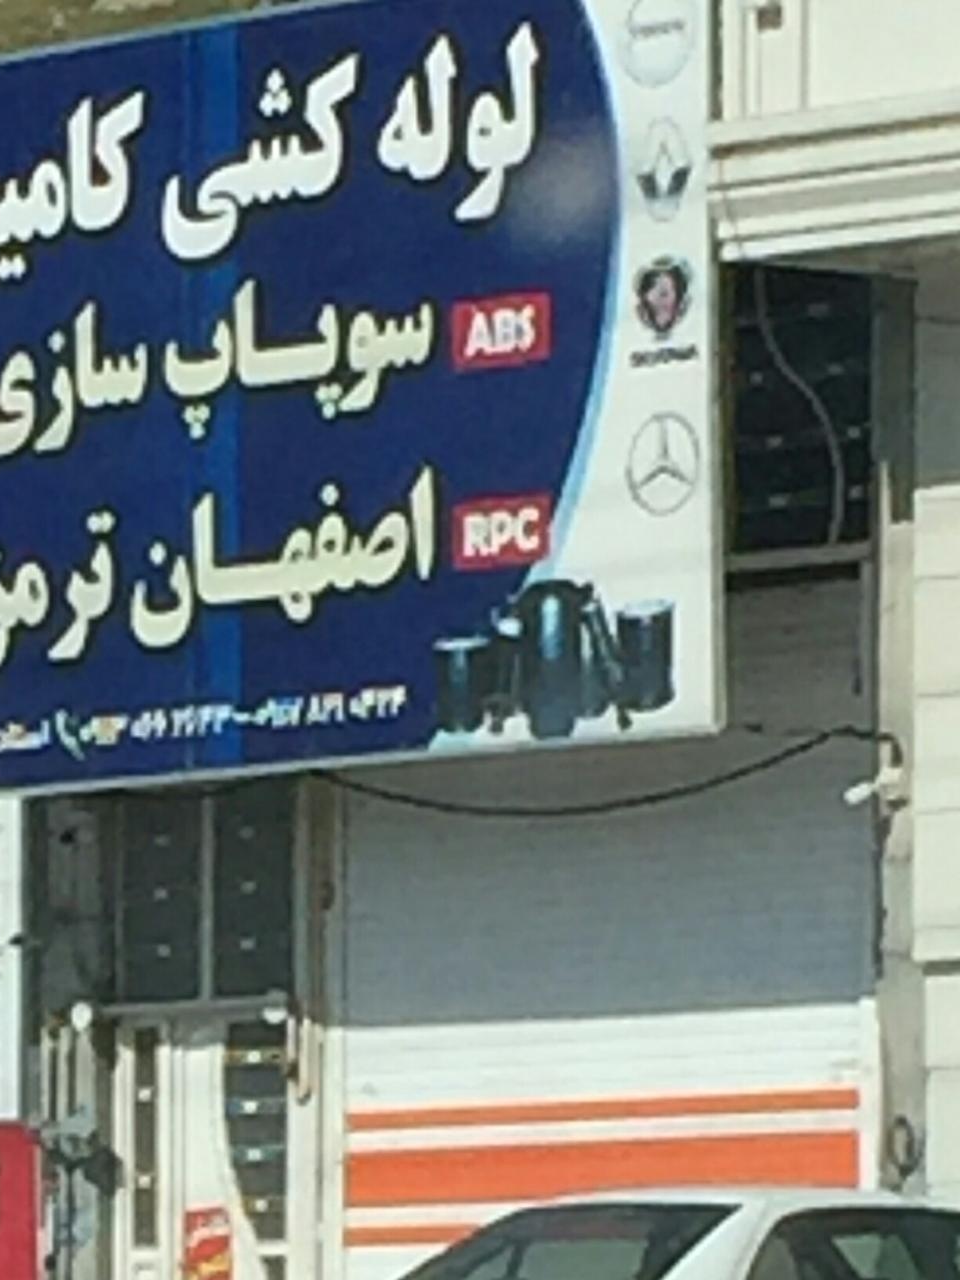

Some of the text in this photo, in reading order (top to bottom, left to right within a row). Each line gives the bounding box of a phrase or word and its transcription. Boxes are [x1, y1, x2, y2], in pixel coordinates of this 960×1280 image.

[160, 53, 359, 260] کشی
[378, 23, 540, 220] لوله
[164, 279, 434, 439] سوپاپ
[464, 304, 536, 354] ABS
[130, 465, 434, 648] اصفهان
[462, 508, 540, 557] RPC
